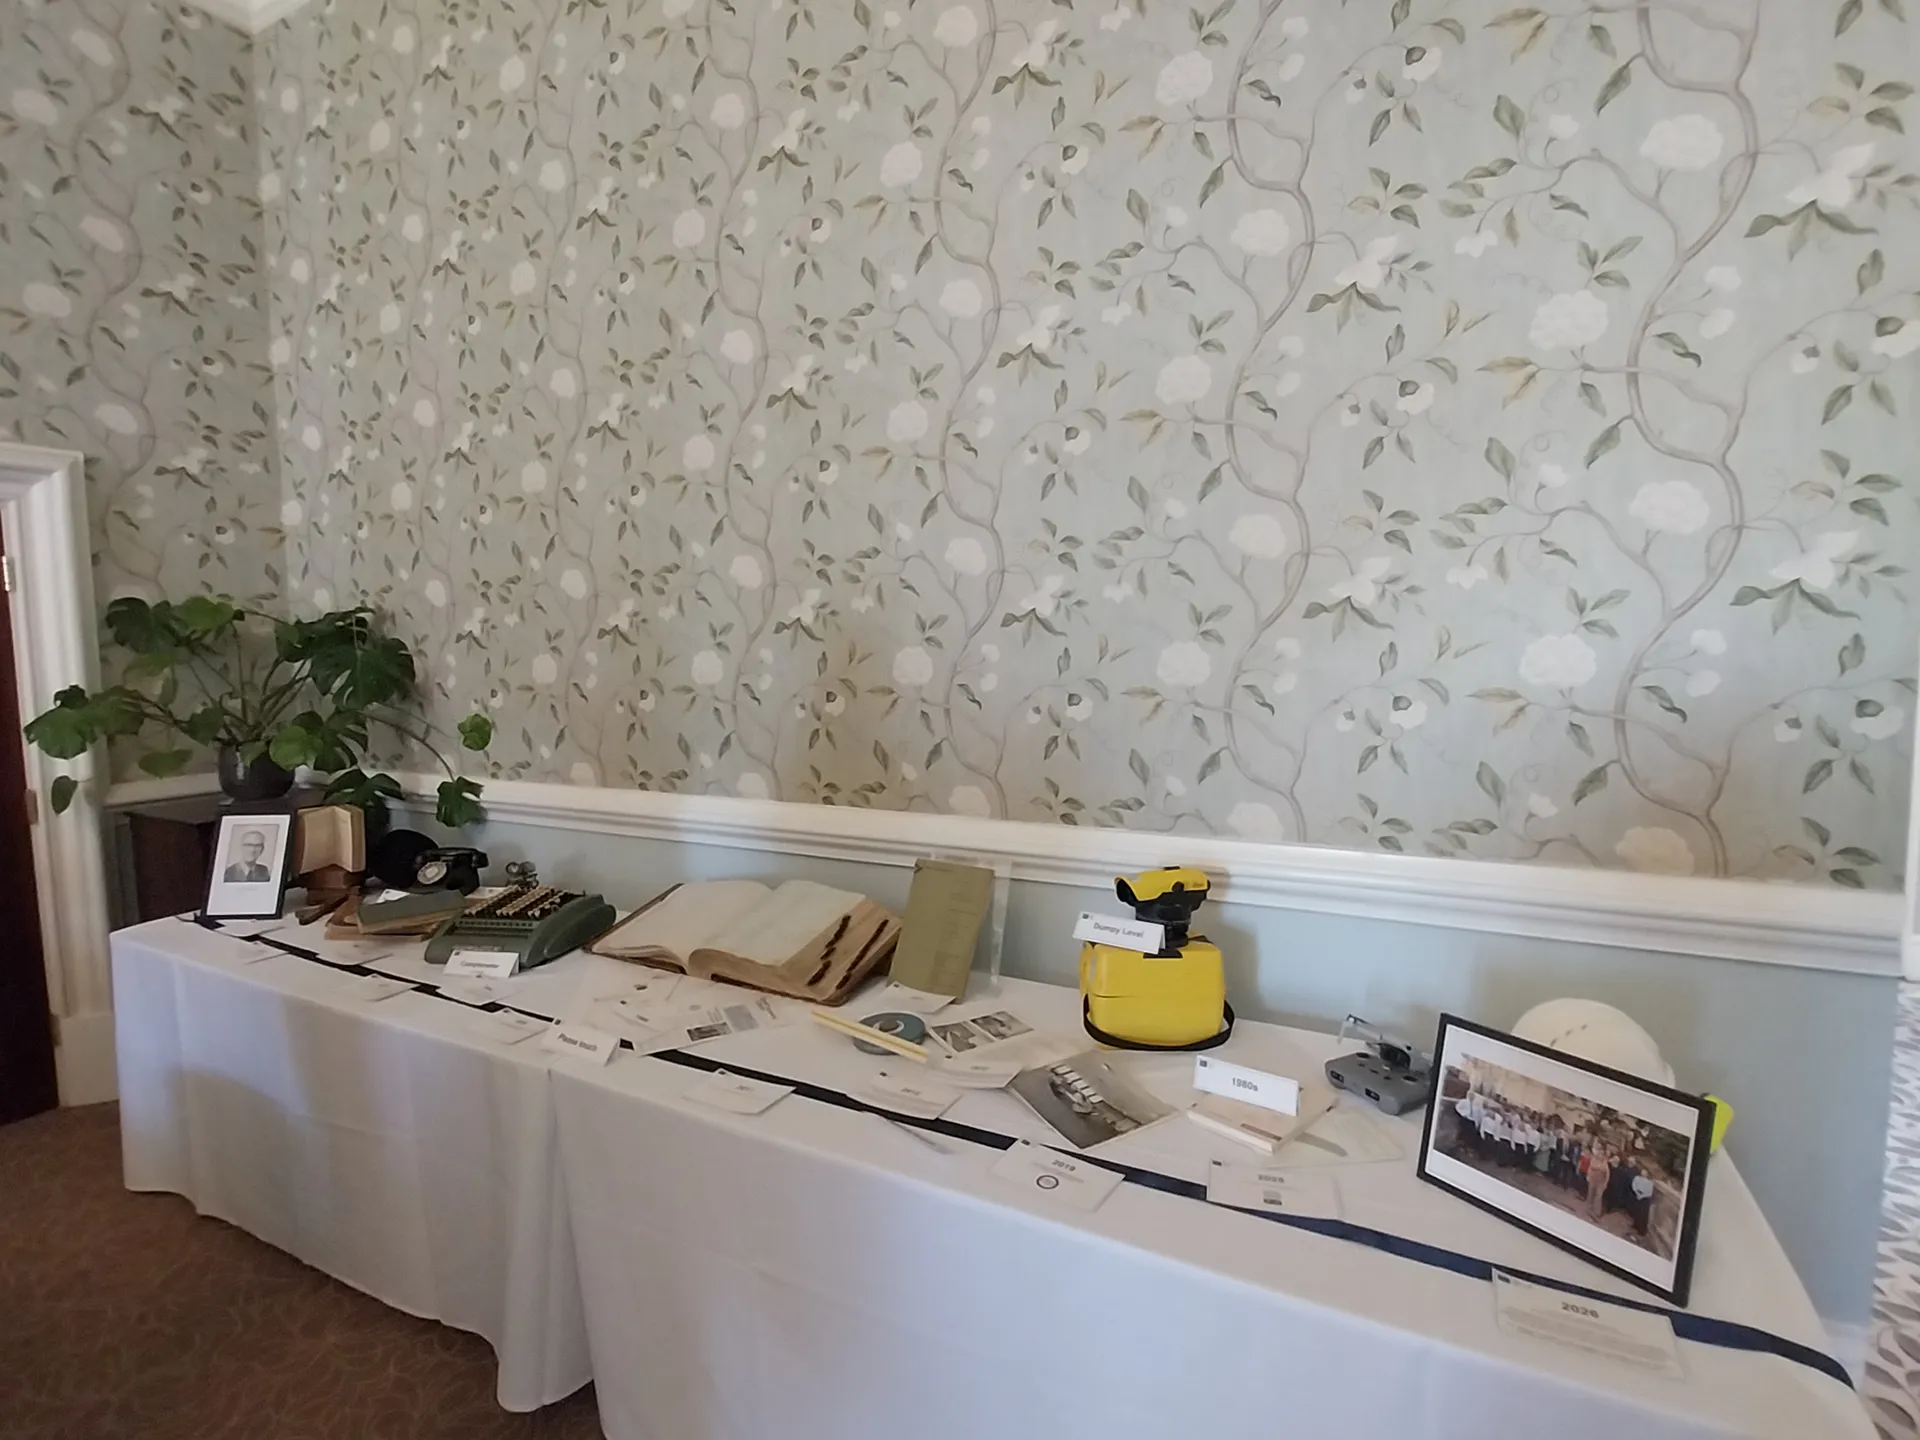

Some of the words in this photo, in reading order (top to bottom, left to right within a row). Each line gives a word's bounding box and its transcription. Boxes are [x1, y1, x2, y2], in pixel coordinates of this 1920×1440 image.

[1094, 922, 1120, 934] Dumpy
[1232, 1077, 1258, 1091] 1980s
[1052, 1160, 1076, 1172] 2019
